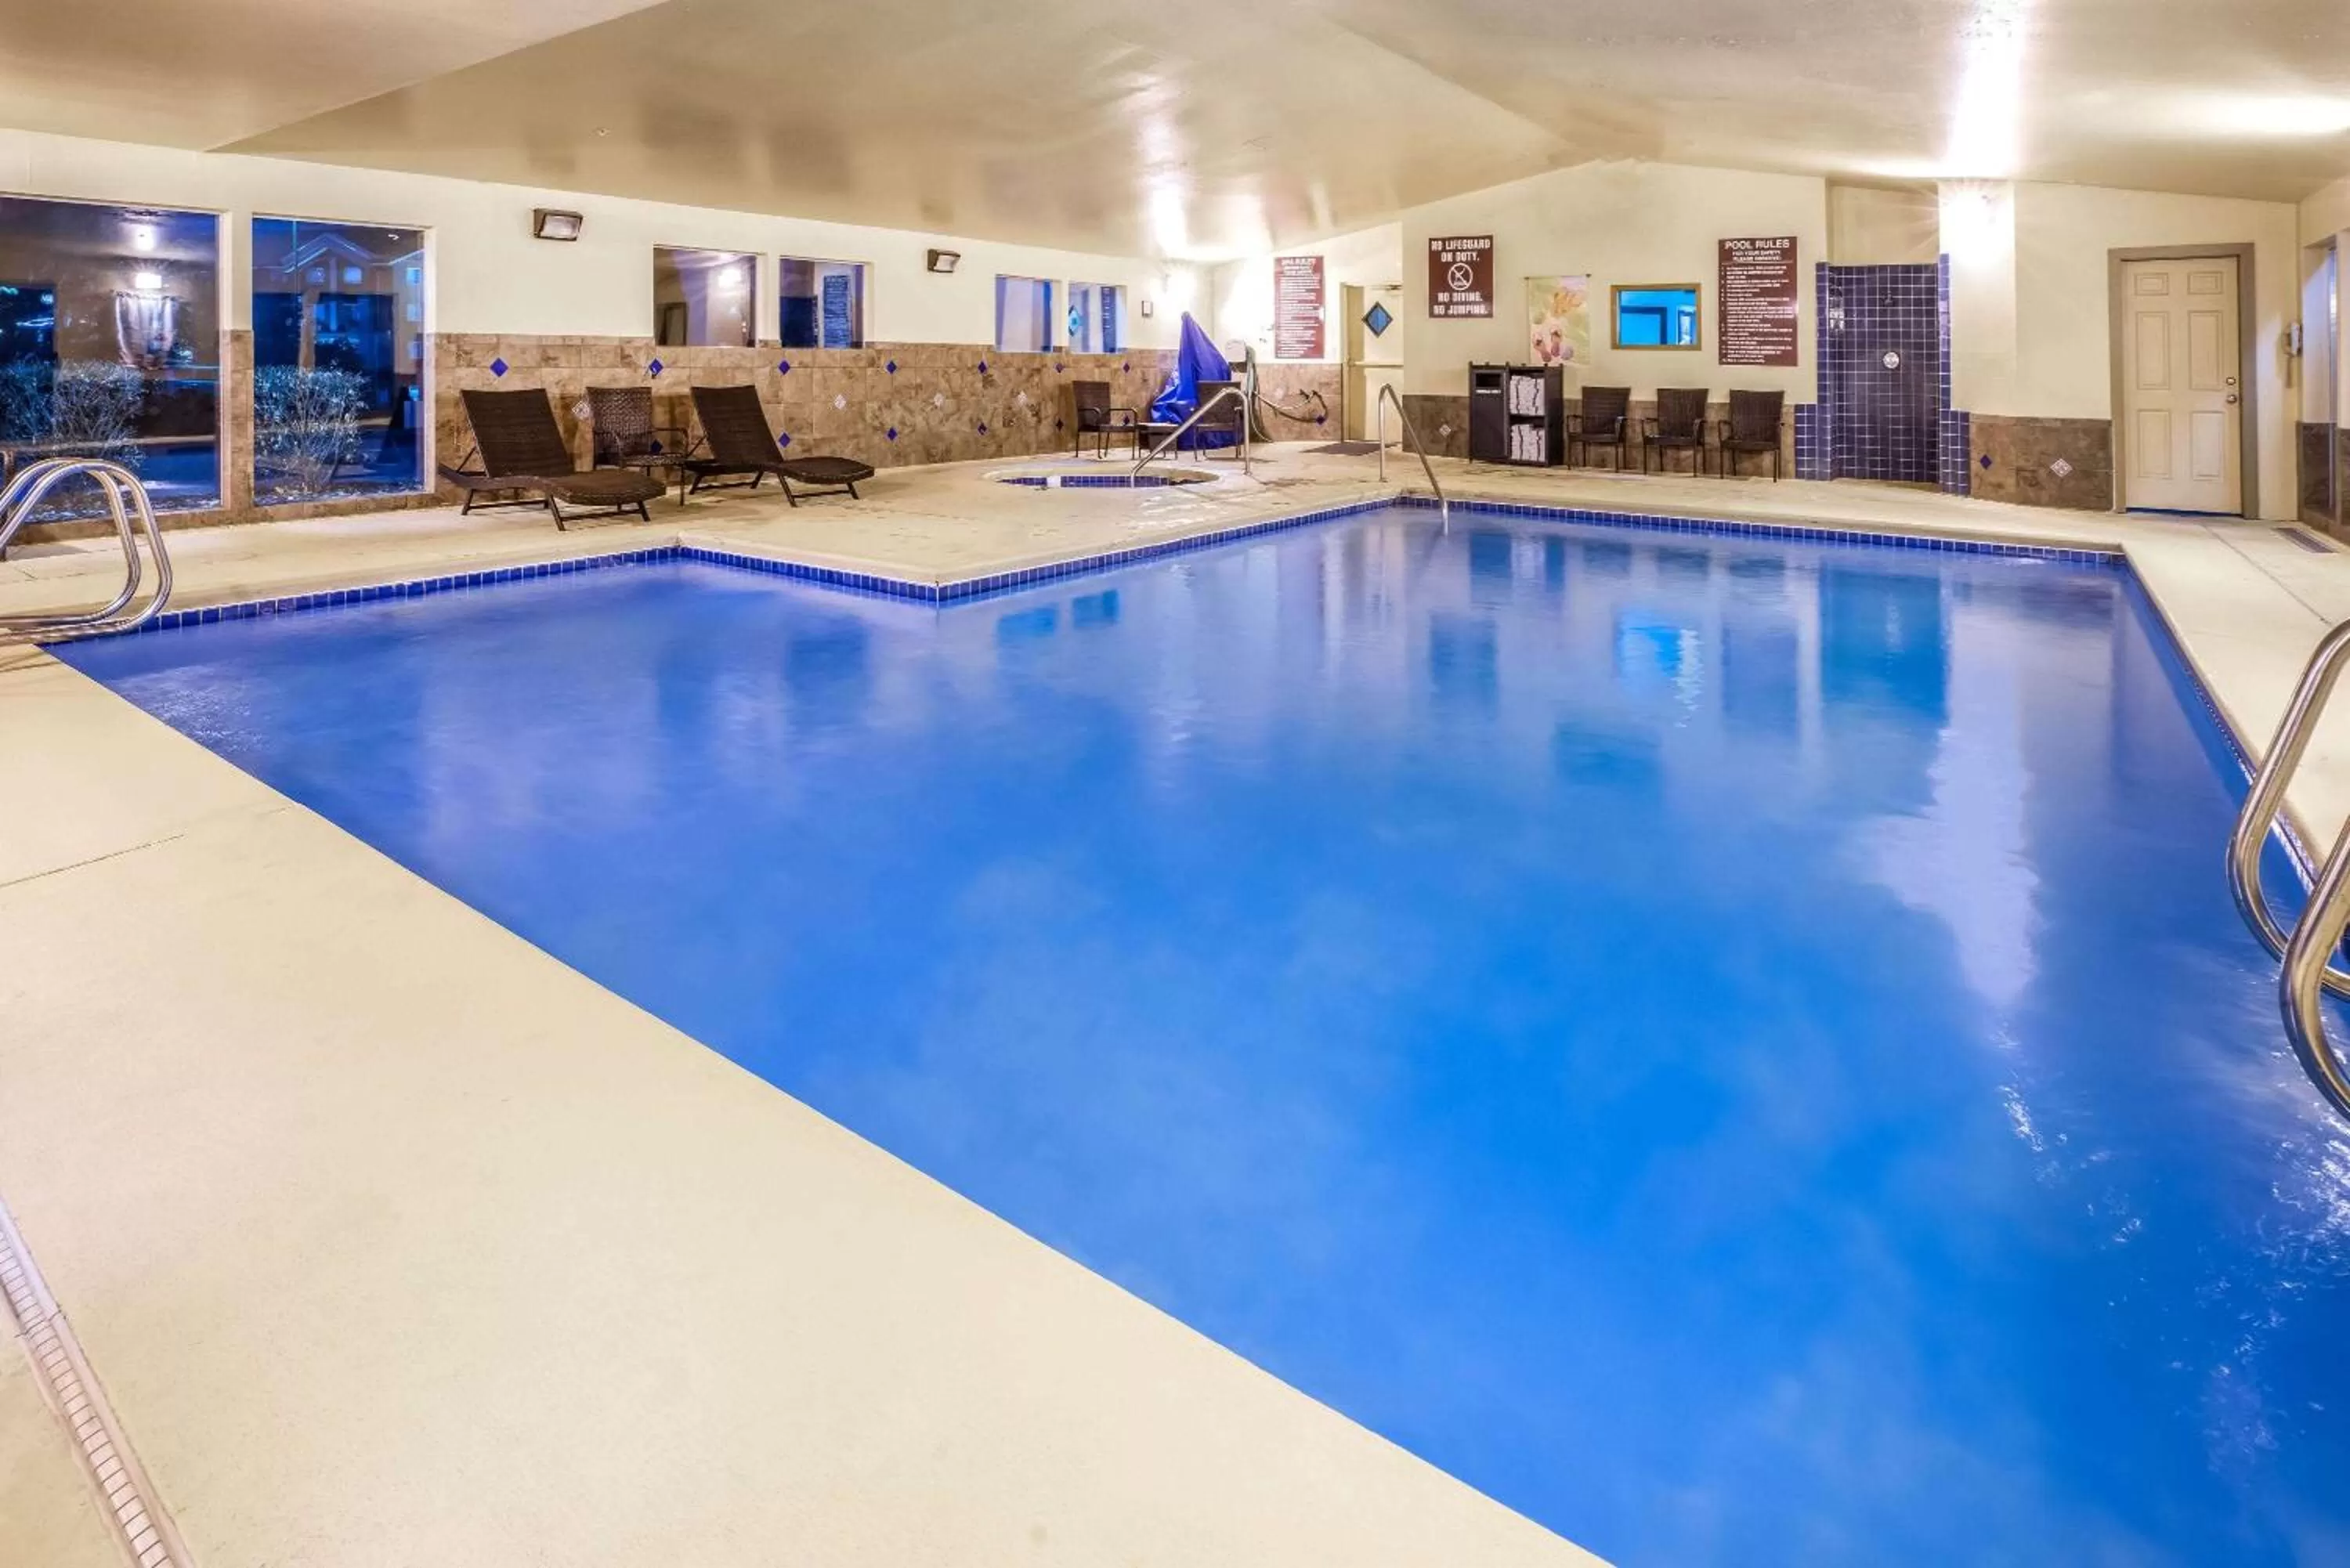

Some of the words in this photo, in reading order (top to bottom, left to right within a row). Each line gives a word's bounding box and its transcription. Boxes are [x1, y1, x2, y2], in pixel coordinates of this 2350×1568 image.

[1431, 240, 1442, 251] NO
[1445, 239, 1491, 250] LIFEGUARD
[1724, 240, 1754, 250] POOL
[1755, 239, 1790, 248] RULES
[1441, 251, 1453, 262] ON
[1455, 251, 1480, 262] DUTY.
[1437, 292, 1450, 302] NO
[1433, 305, 1445, 315] NO
